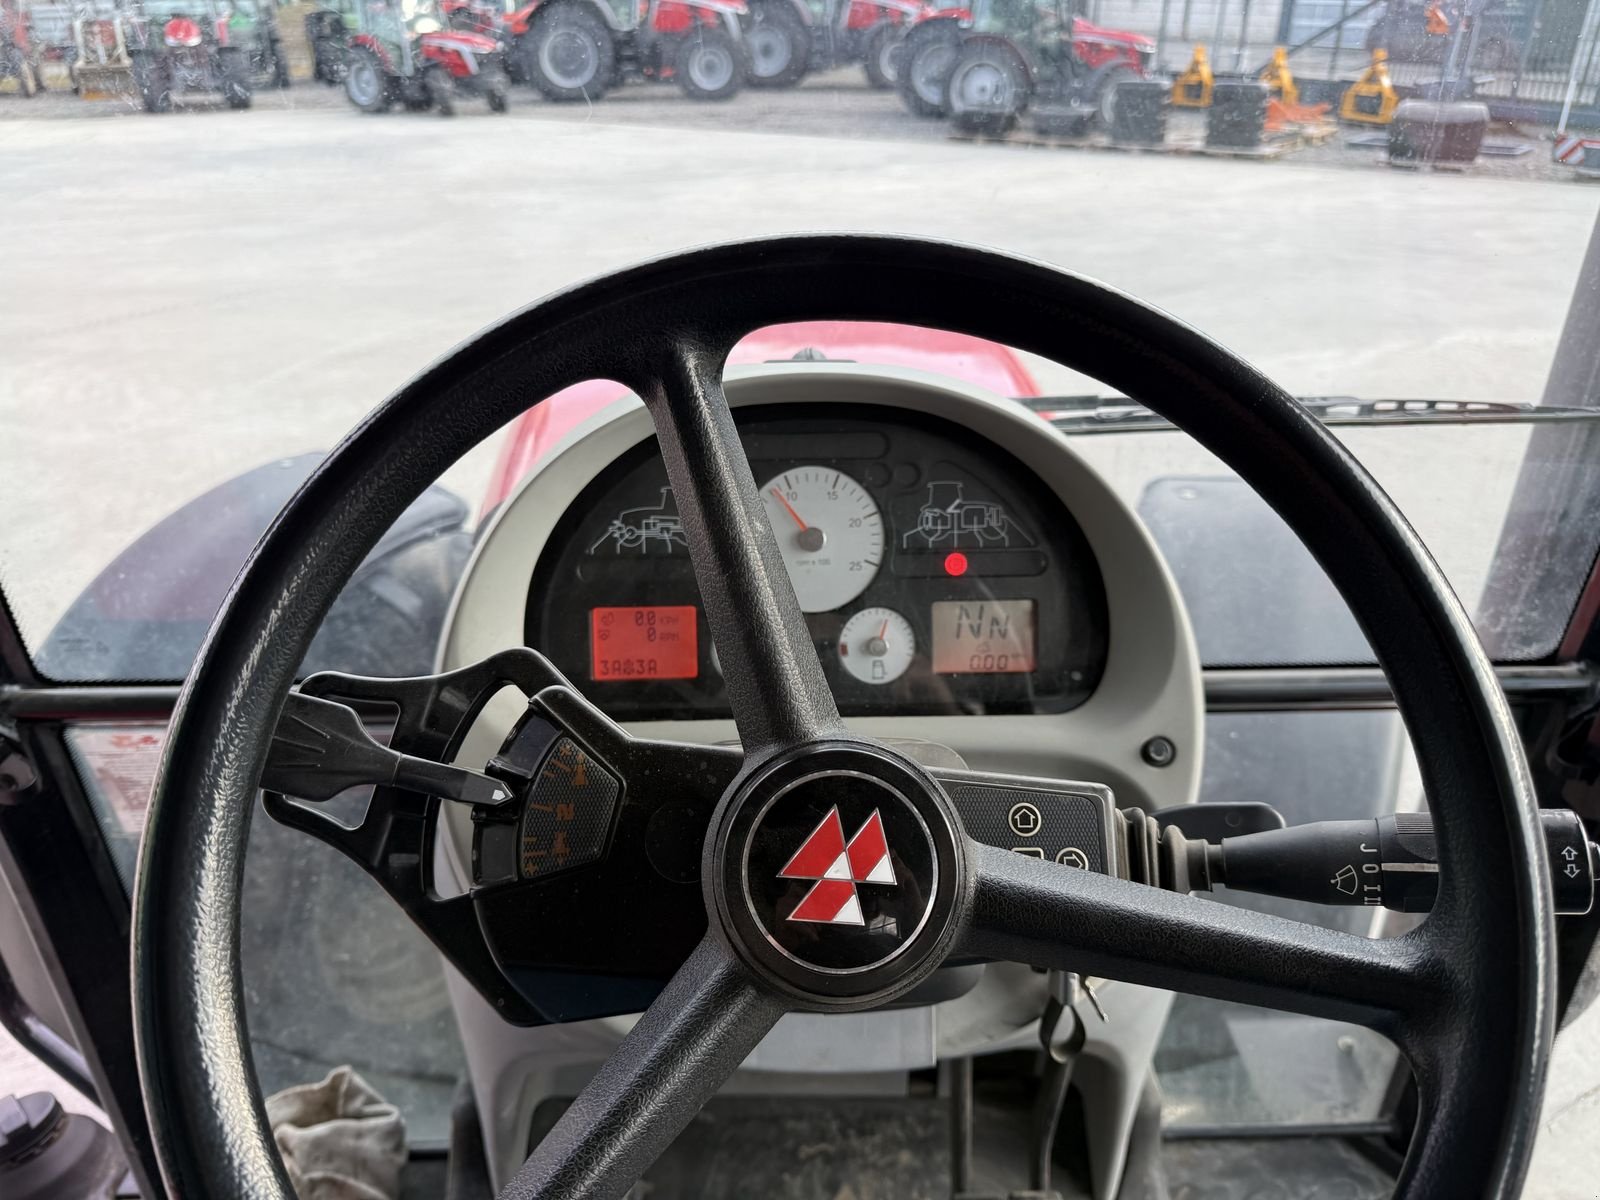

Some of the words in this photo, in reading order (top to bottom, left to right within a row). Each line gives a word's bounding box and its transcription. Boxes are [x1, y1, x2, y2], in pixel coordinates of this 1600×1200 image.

[786, 491, 798, 501] 10
[827, 491, 839, 501] 15
[849, 518, 862, 528] 20
[849, 561, 862, 572] 25
[647, 627, 656, 642] 0
